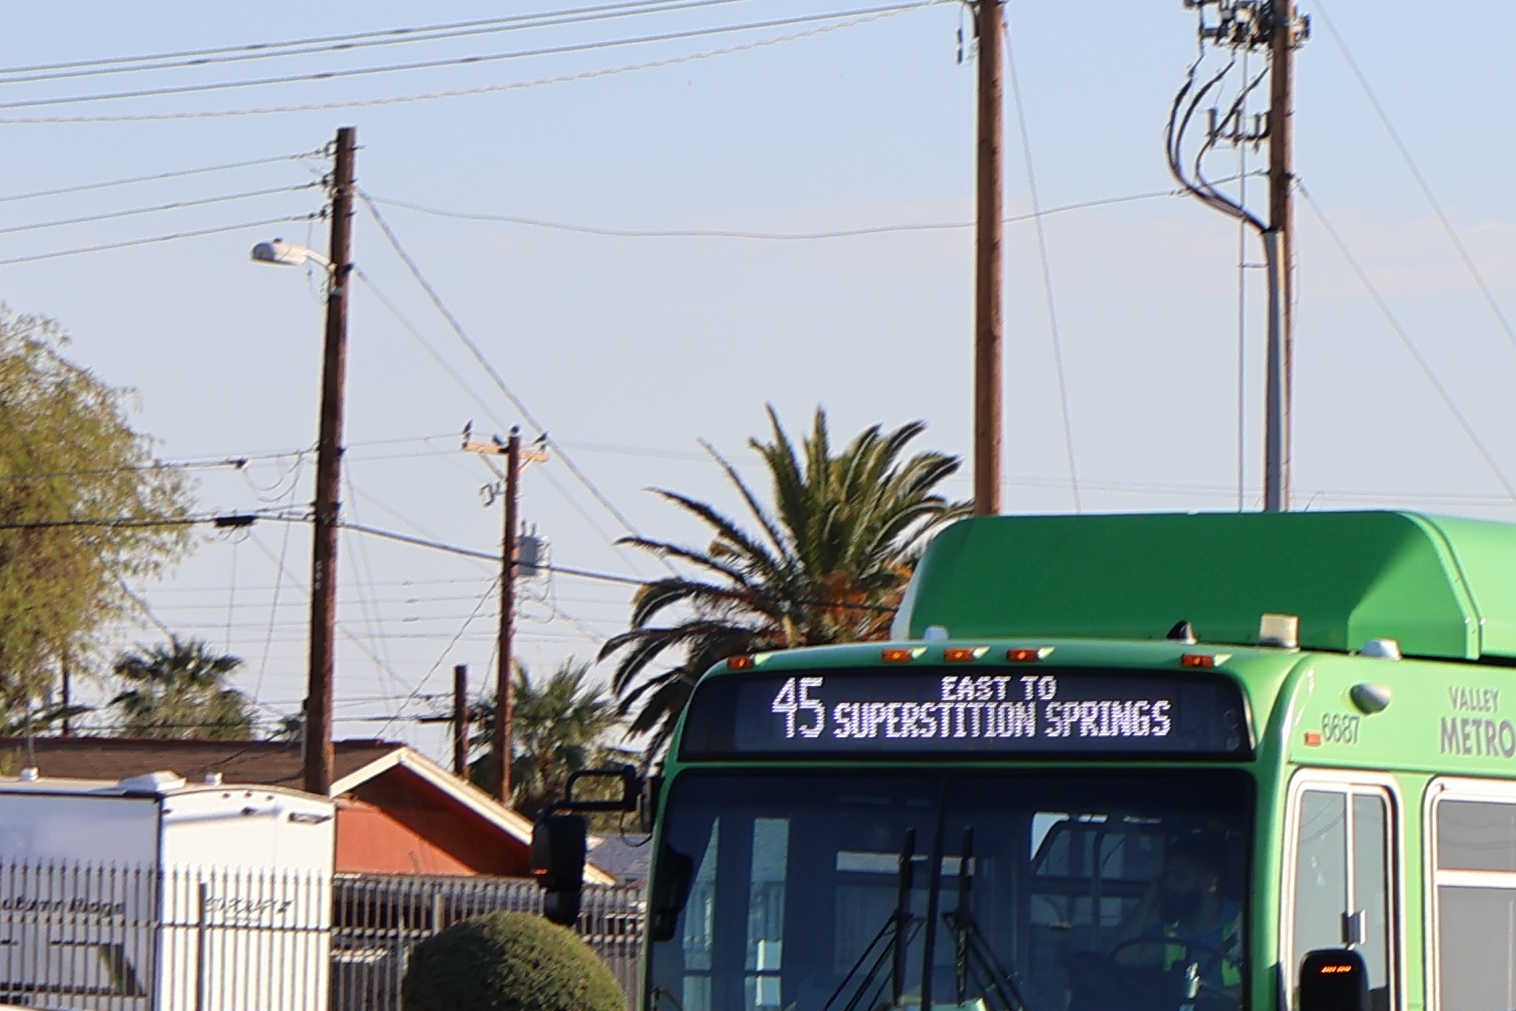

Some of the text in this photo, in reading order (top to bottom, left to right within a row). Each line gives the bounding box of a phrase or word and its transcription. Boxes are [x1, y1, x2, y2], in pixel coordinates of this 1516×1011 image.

[940, 675, 1058, 701] EAST TO
[1448, 686, 1499, 714] VALLEY
[771, 676, 825, 738] 45
[832, 699, 1172, 739] SUPERSTITION SPRINGS
[1320, 712, 1361, 745] 6687
